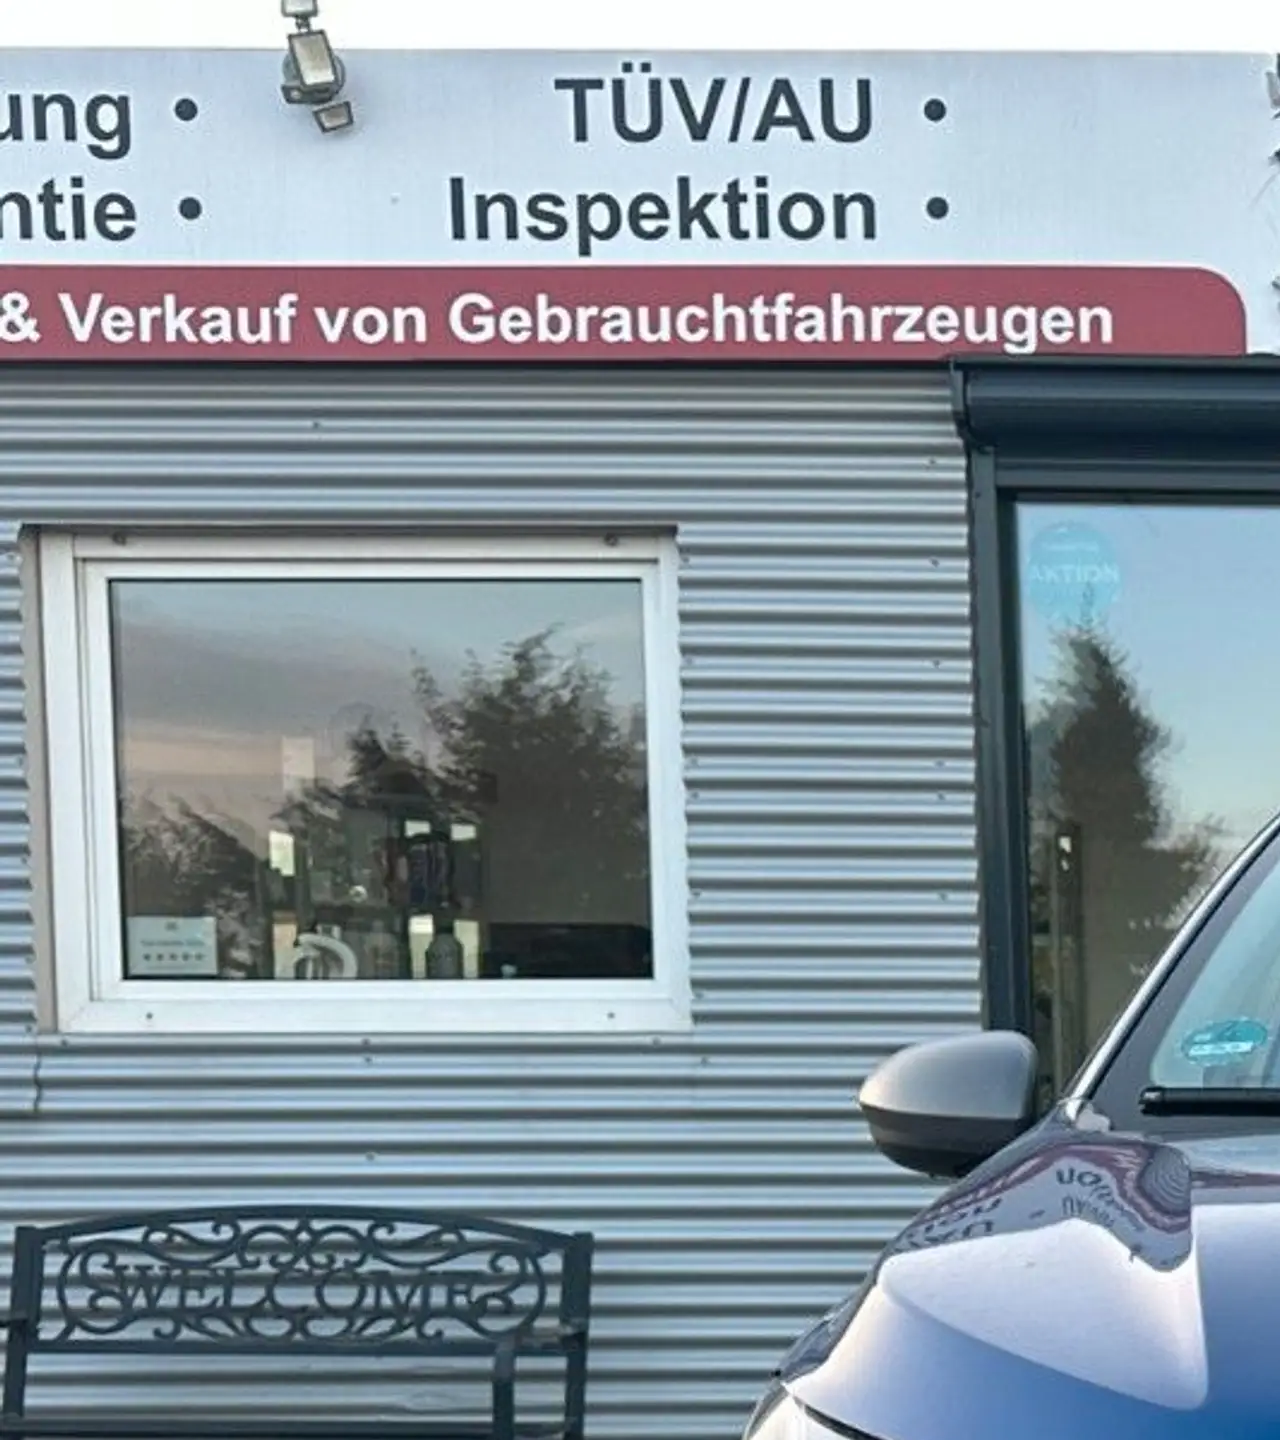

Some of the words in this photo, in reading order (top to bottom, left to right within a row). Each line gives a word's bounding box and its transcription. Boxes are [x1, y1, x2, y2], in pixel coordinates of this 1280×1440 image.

[555, 62, 872, 143] TÜV/AU
[449, 176, 876, 257] Inspektion
[0, 291, 41, 343] &
[57, 292, 299, 344] Verkauf
[314, 306, 427, 344] von
[449, 292, 1113, 354] Gebrauchtfahrzeugen
[116, 1265, 478, 1316] WELCOME
